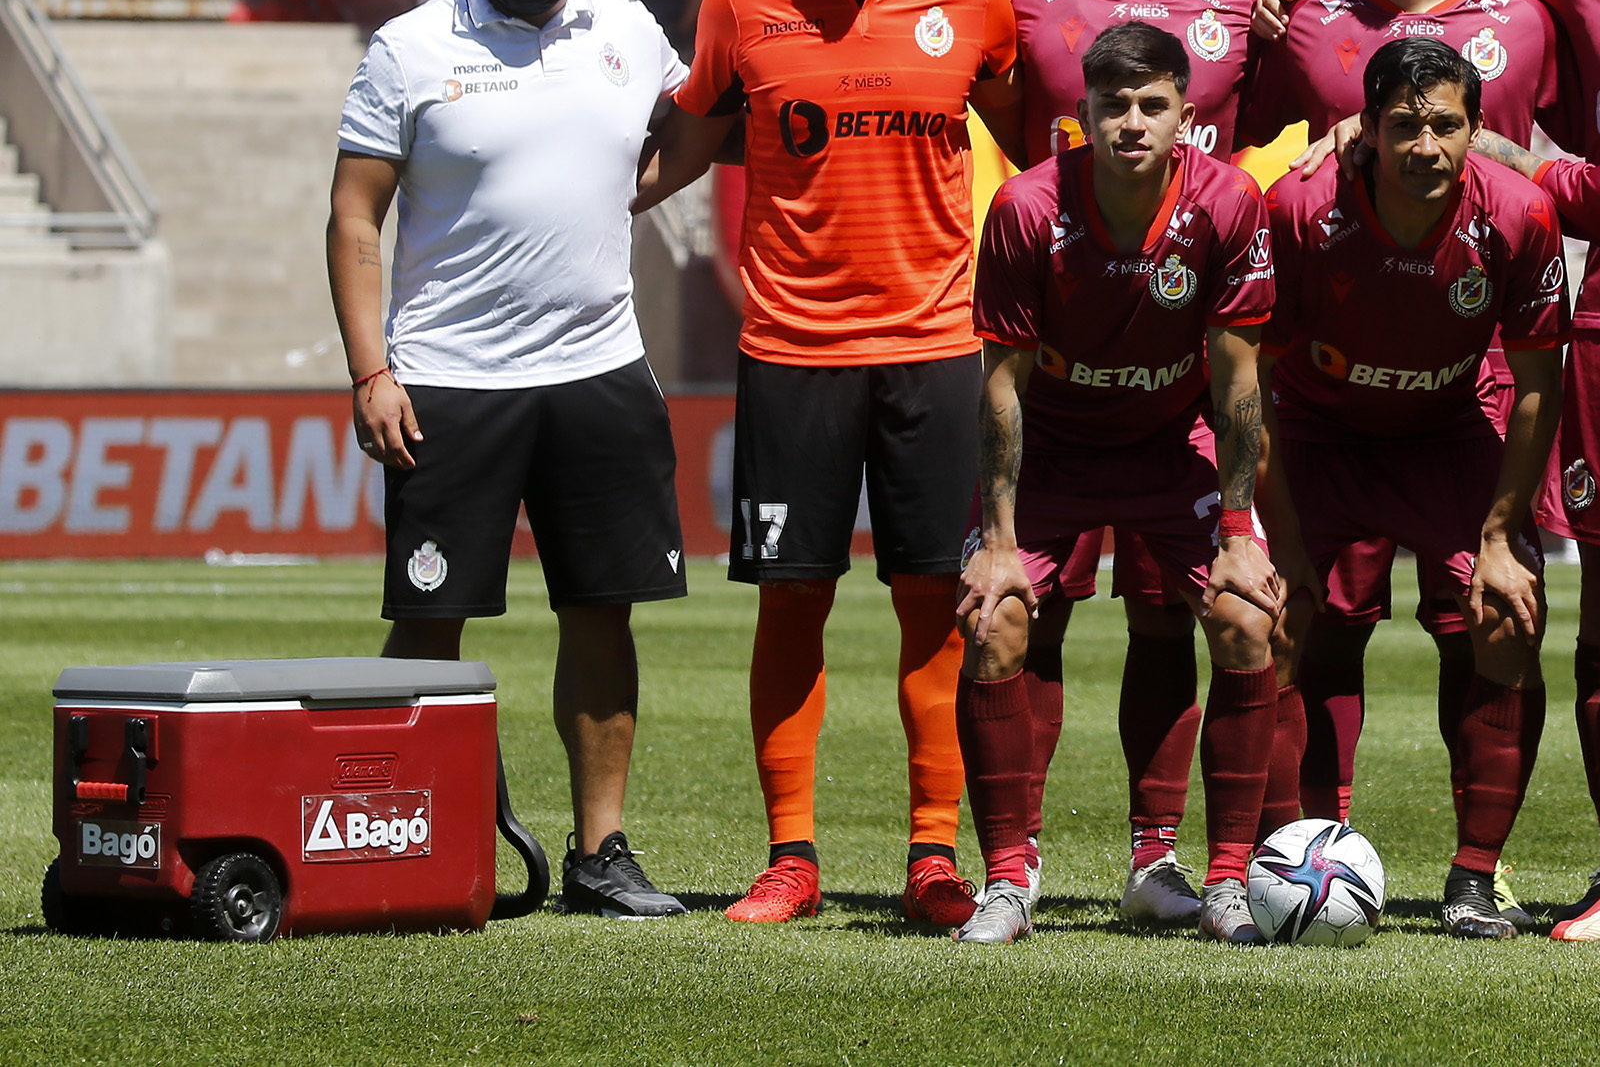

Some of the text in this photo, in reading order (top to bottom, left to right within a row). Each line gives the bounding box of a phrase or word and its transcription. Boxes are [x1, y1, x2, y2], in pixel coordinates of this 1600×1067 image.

[1130, 5, 1170, 19] MEDS
[764, 18, 825, 35] macron
[1405, 23, 1445, 37] MEDS
[453, 63, 503, 76] macron
[464, 79, 518, 95] BETANO
[855, 75, 893, 89] MEDS
[834, 110, 947, 138] BETANO
[1120, 261, 1156, 275] MEDS
[1397, 261, 1436, 277] MEDS
[1070, 352, 1195, 392] BETANO
[1348, 353, 1477, 391] BETANO
[741, 498, 789, 561] 17
[346, 807, 429, 854] Bagó
[81, 822, 157, 865] Bagó
